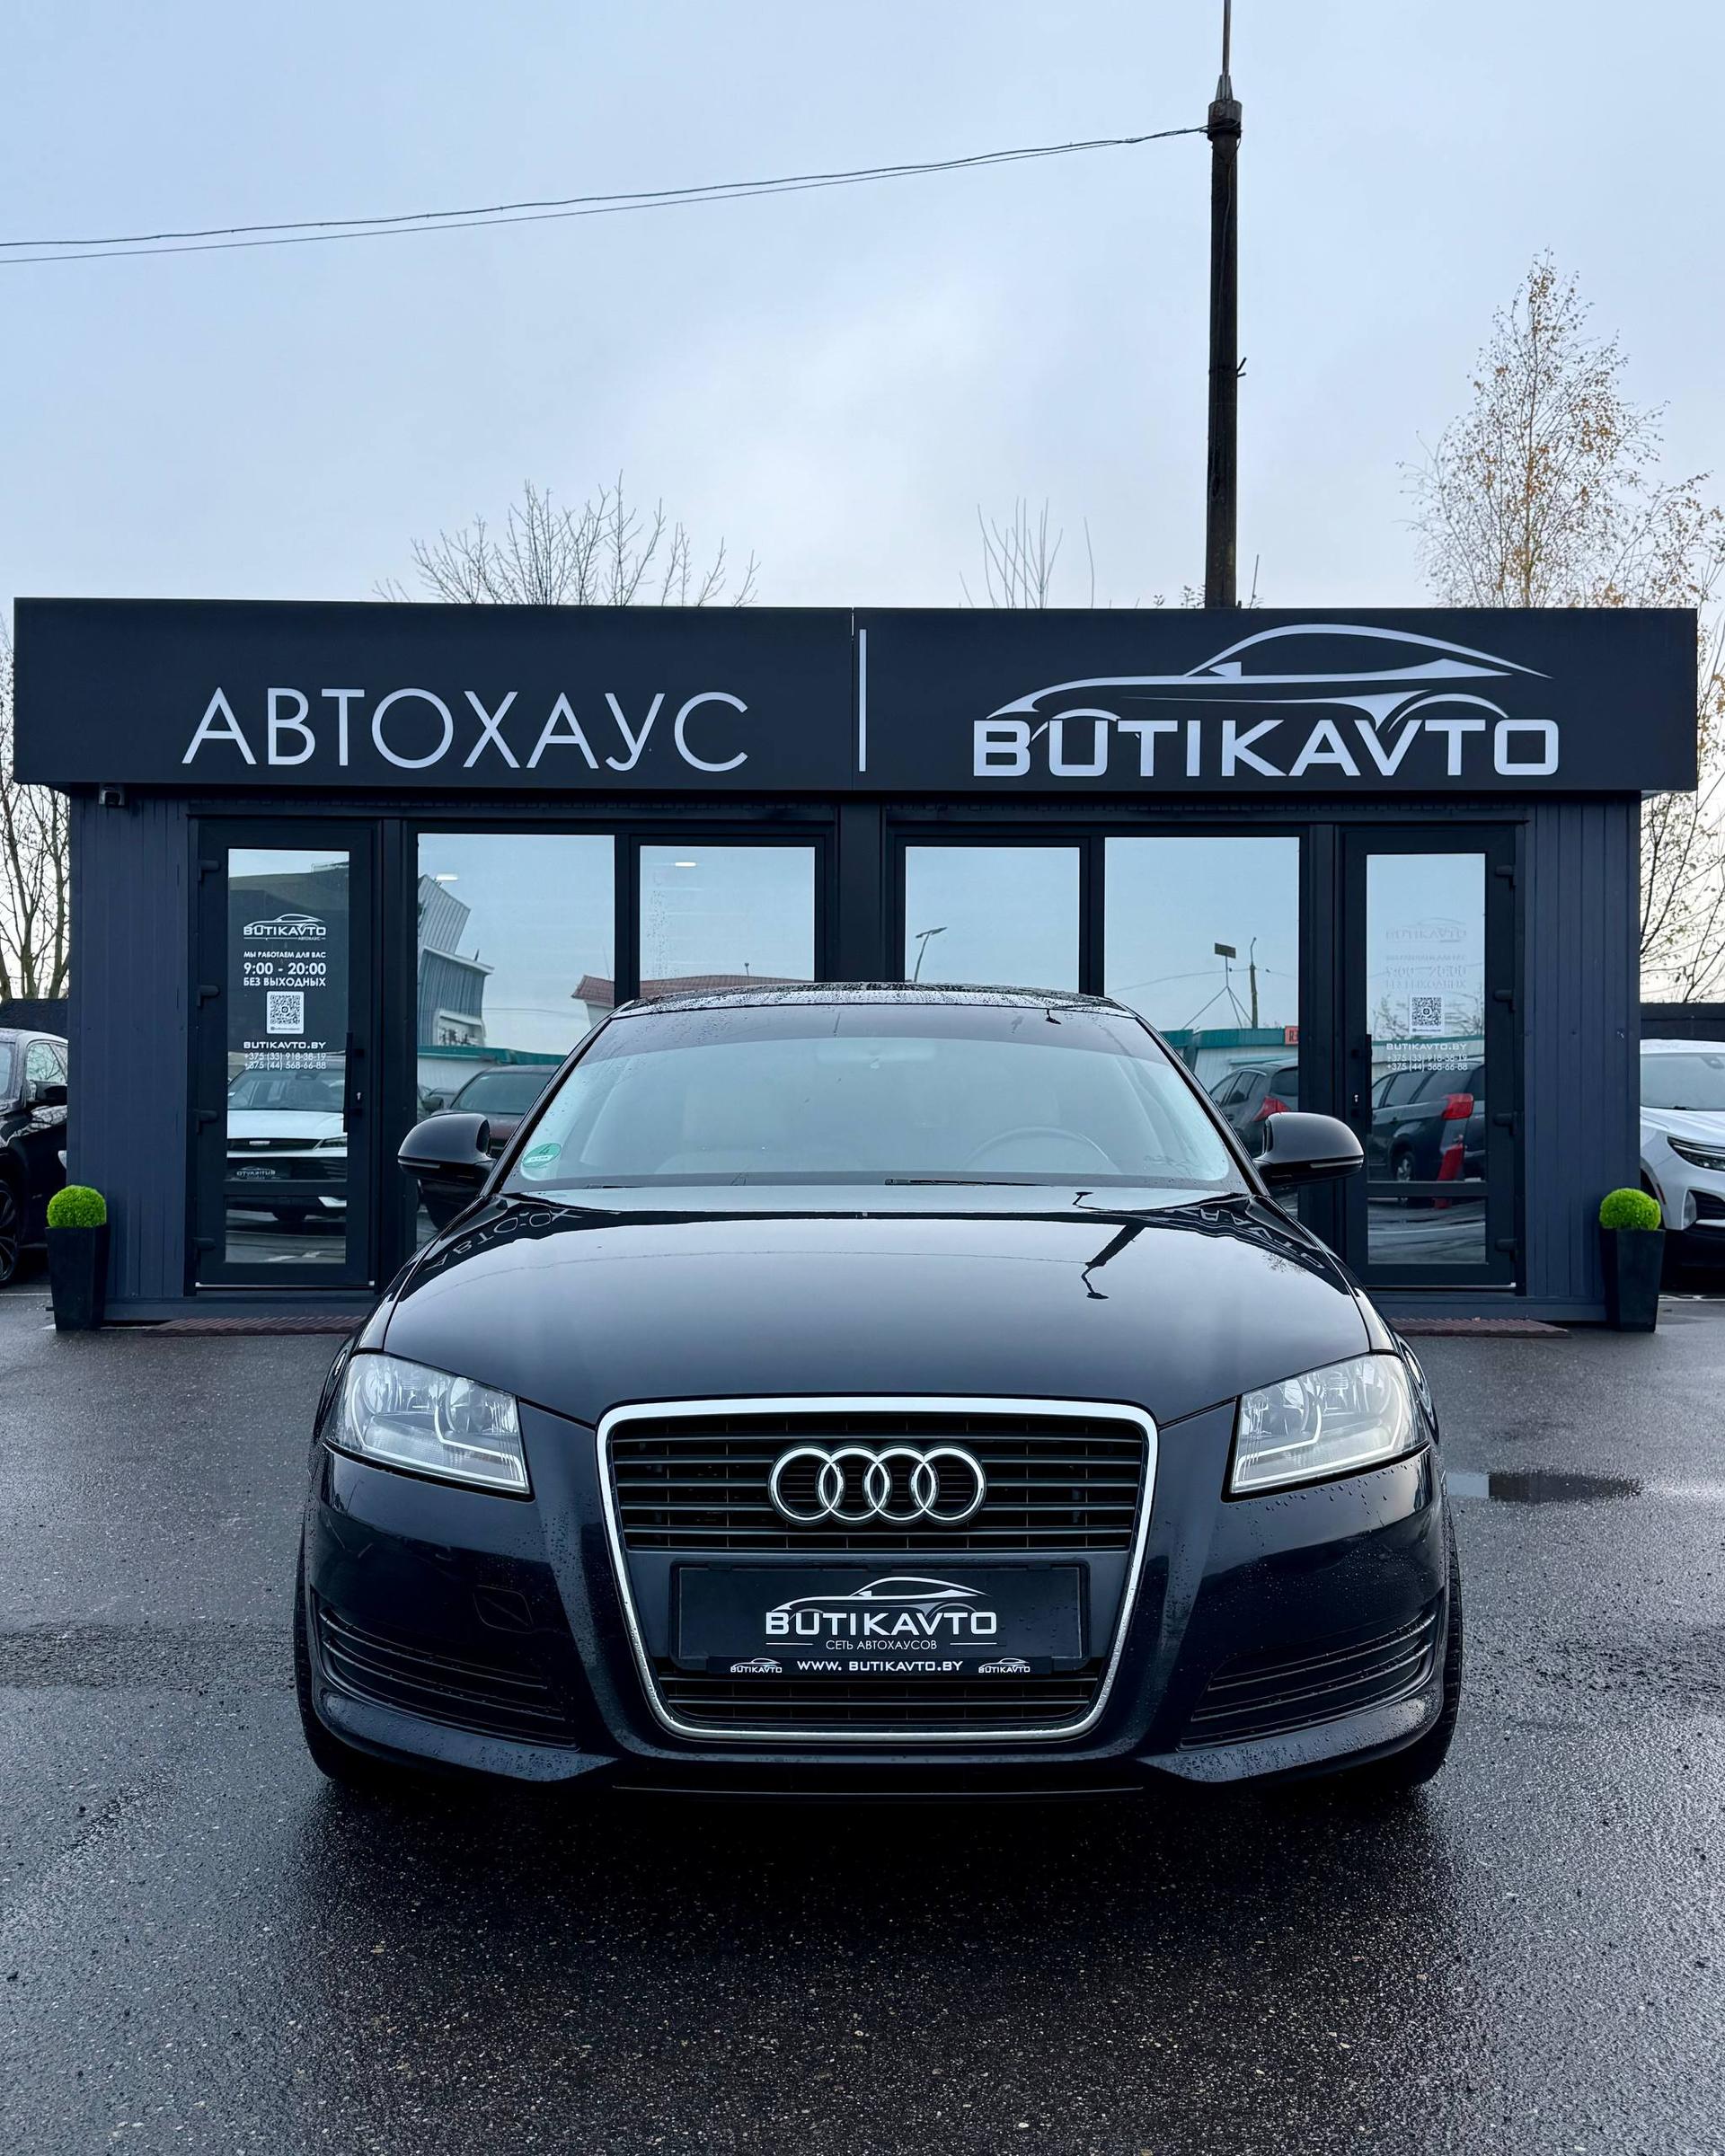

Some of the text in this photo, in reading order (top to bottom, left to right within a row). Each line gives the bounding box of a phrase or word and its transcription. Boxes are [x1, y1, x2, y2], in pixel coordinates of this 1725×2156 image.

[181, 686, 749, 773] АВТОХАУС
[973, 719, 1560, 777] BUTIKAVTO
[243, 925, 326, 936] BUTIKAVTO
[295, 951, 310, 959] ДЛЯ
[243, 962, 273, 976] 9:00
[288, 962, 326, 976] 20:00
[243, 976, 326, 987] БЕЗ ВЫХОДНЫХ
[243, 1041, 327, 1050] BUTIKAVTO.BY
[1386, 1043, 1468, 1051] BUTIKAVTO.BY
[267, 1061, 282, 1071] (44)
[1387, 1063, 1408, 1071] +375
[1409, 1062, 1425, 1073] (44)
[765, 1612, 997, 1636] BUTIKAVTO
[826, 1639, 938, 1651] СЕТЬ АВТОХАУСОВ
[848, 1660, 964, 1672] BUTIKAVTO.BY
[978, 1666, 1031, 1674] BUTIKAVTO
